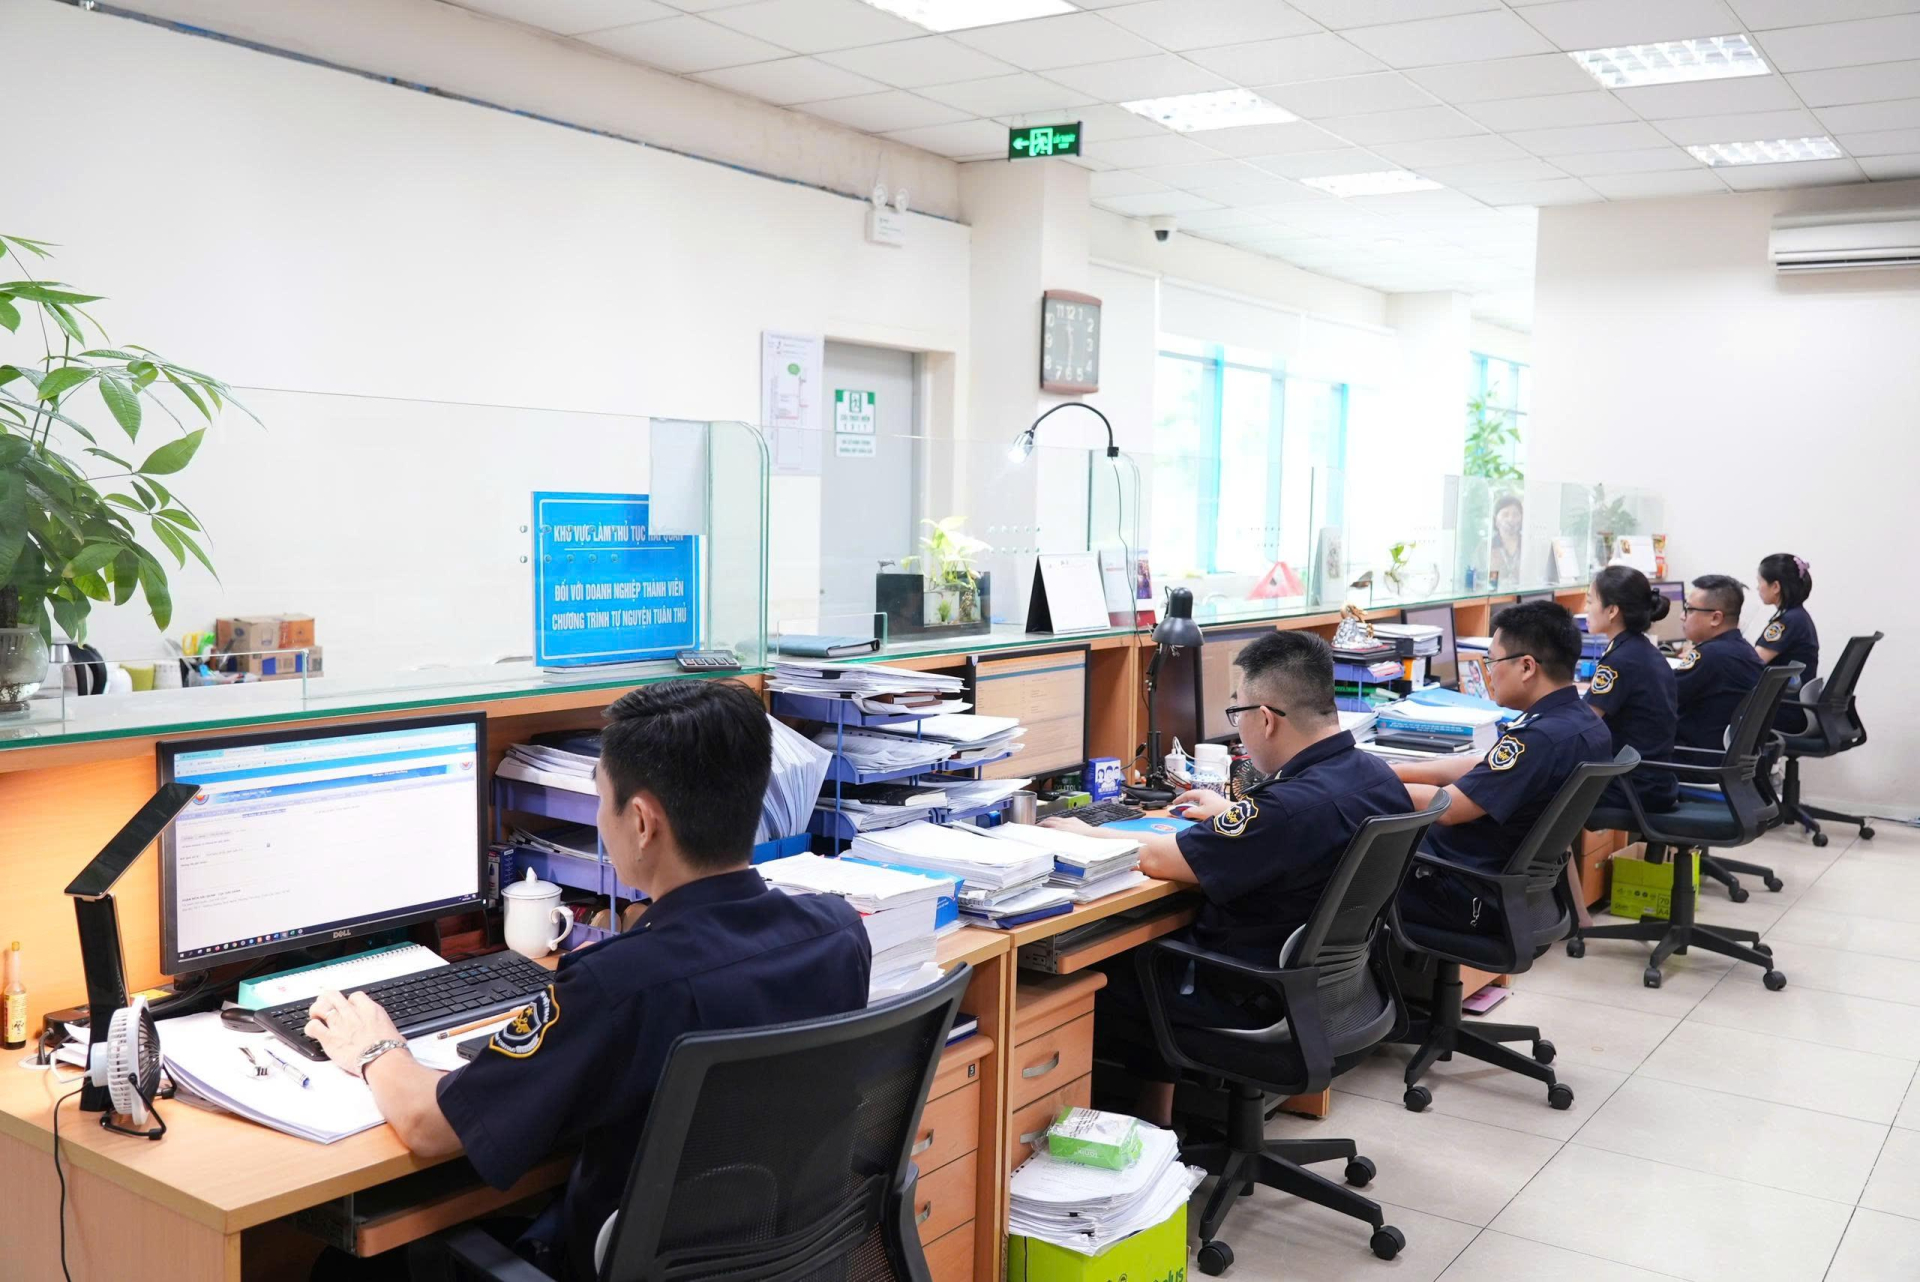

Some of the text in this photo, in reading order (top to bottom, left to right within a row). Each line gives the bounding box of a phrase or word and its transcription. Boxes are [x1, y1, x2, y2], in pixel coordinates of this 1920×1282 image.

[1056, 304, 1064, 319] 11
[1066, 305, 1075, 320] 12
[1087, 317, 1094, 333] 2
[1055, 364, 1063, 380] 7
[1076, 367, 1084, 382] 5
[553, 520, 646, 546] KHU VỰC LÀM THỦ TỤC
[570, 580, 583, 601] VỚI
[585, 583, 612, 600] DOANH
[613, 579, 641, 602] NGHIỆP
[667, 577, 684, 597] VIÊN
[552, 602, 687, 631] CHƯƠNG TRÌNH TỰ NGUYỆN TUÂN THỦ
[332, 929, 352, 939] DELL
